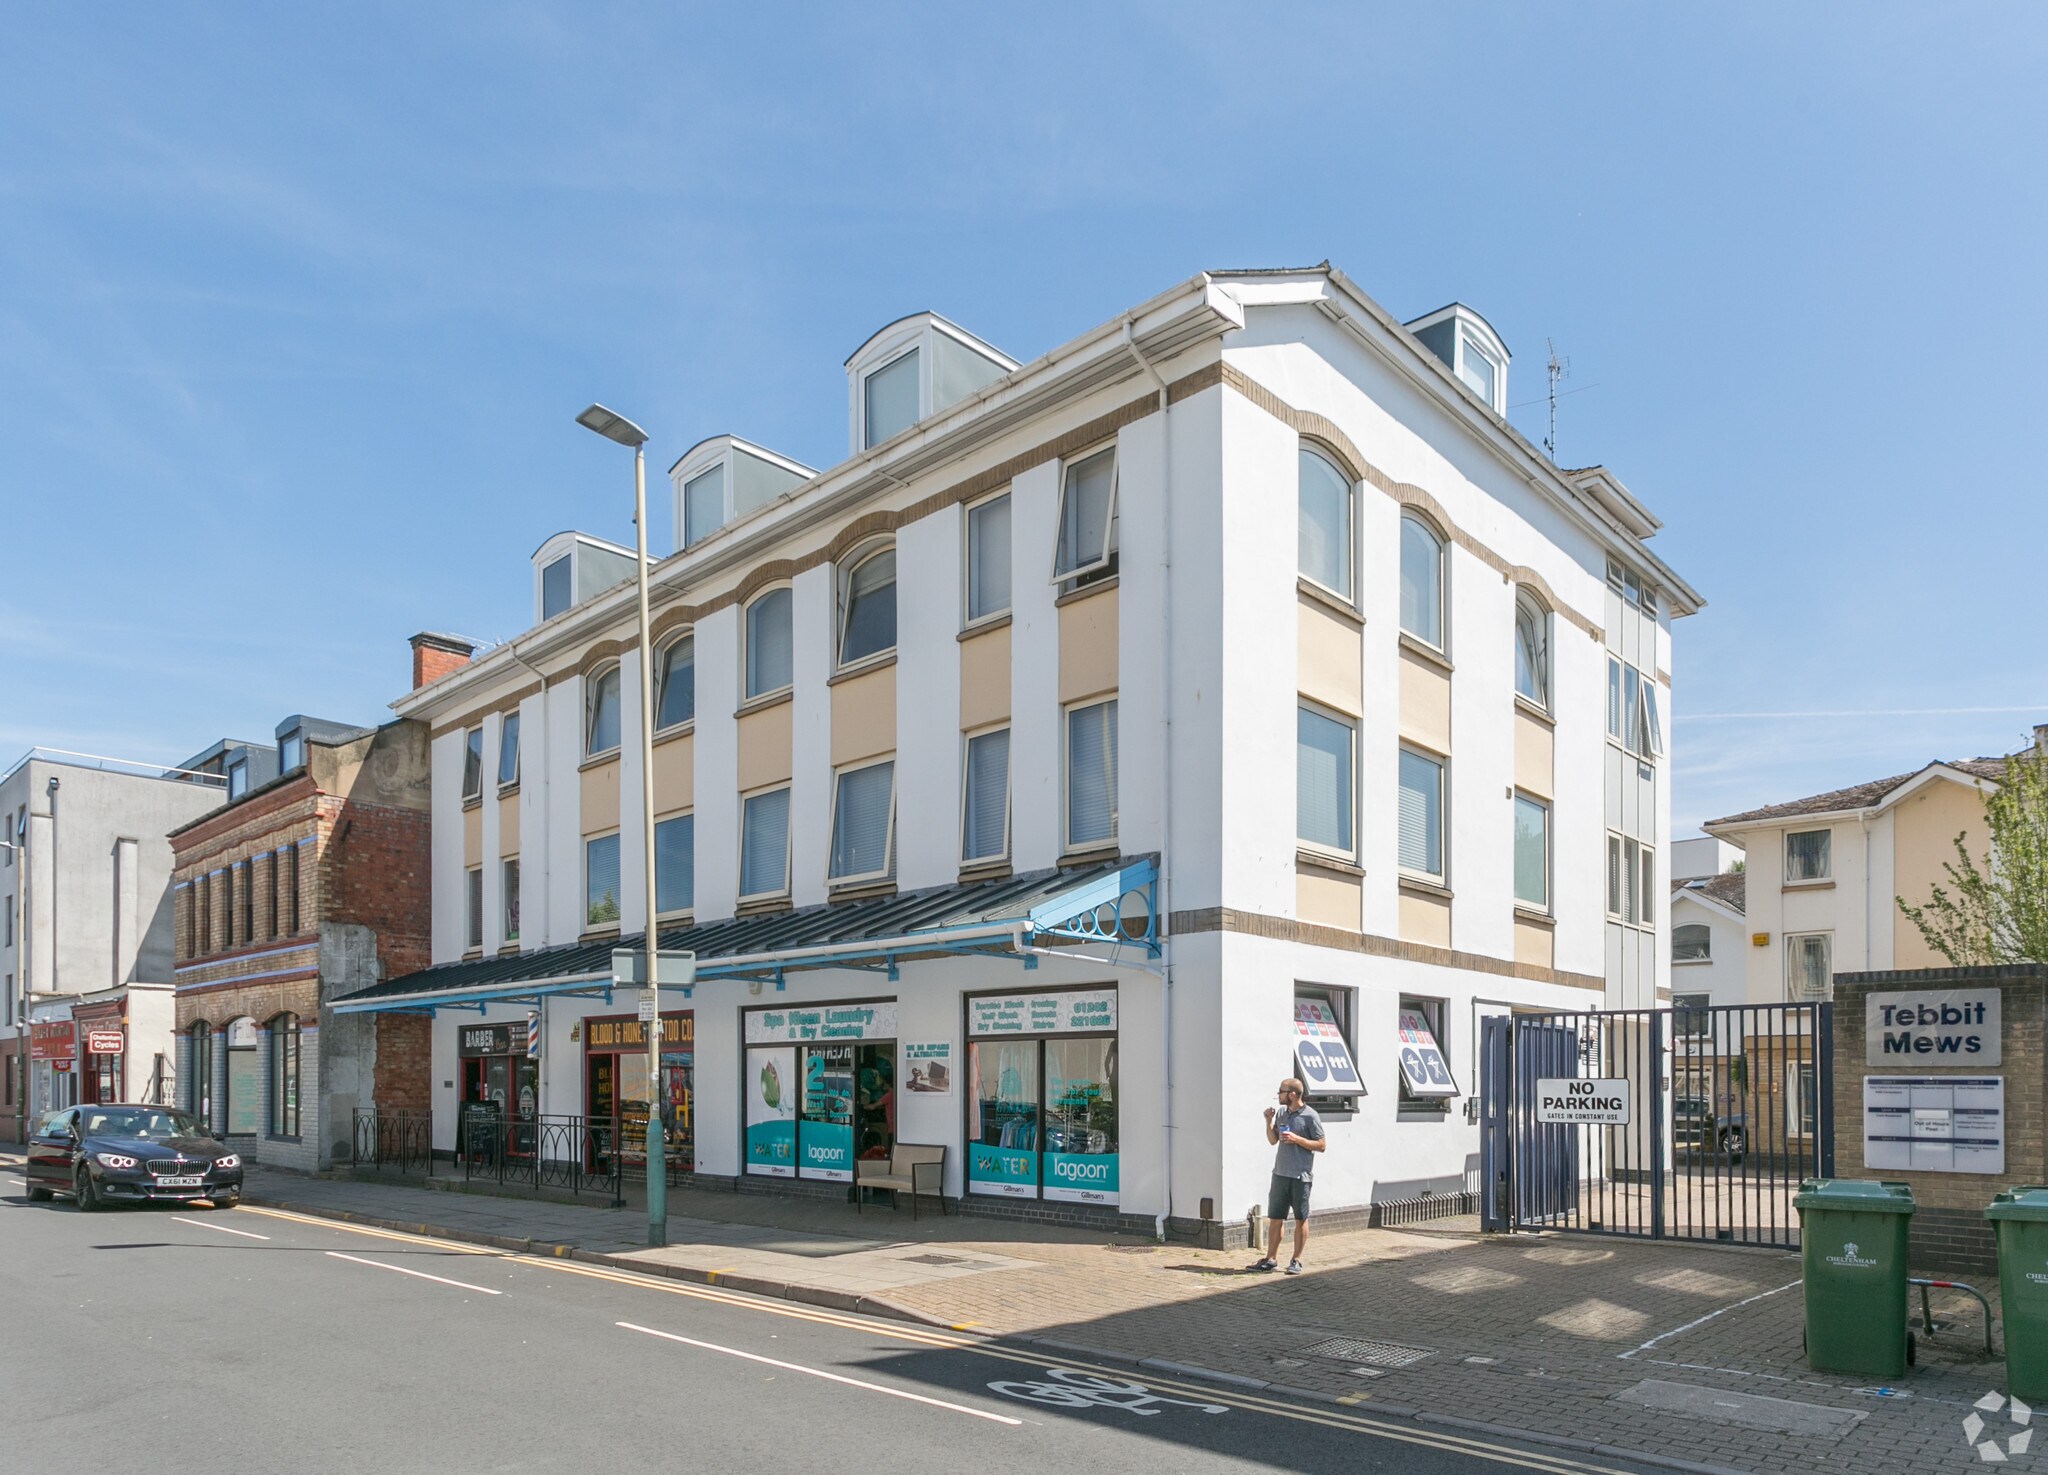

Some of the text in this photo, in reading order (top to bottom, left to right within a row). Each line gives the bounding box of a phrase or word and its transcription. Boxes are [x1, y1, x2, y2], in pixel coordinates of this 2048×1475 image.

[1074, 1001, 1107, 1013] 01242
[1880, 1002, 1986, 1026] Tebbit
[764, 1012, 784, 1029] Spa
[825, 1007, 874, 1025] Laundry
[466, 1029, 493, 1047] BARBER
[591, 1023, 613, 1044] BLOOD
[615, 1022, 620, 1043] &
[682, 1018, 695, 1041] CO.
[801, 1027, 817, 1040] Dry
[821, 1025, 863, 1038] Cleaning
[94, 1041, 120, 1049] Cycles
[1884, 1032, 1981, 1053] Mews
[806, 1055, 824, 1090] 2
[1569, 1082, 1595, 1095] NO
[1543, 1097, 1622, 1110] PARKING
[755, 1142, 791, 1159] WATER
[808, 1144, 844, 1162] lagoon
[977, 1155, 1030, 1176] WATER
[1054, 1157, 1107, 1181] lagoon
[1825, 1255, 1877, 1265] CHELTENHAM
